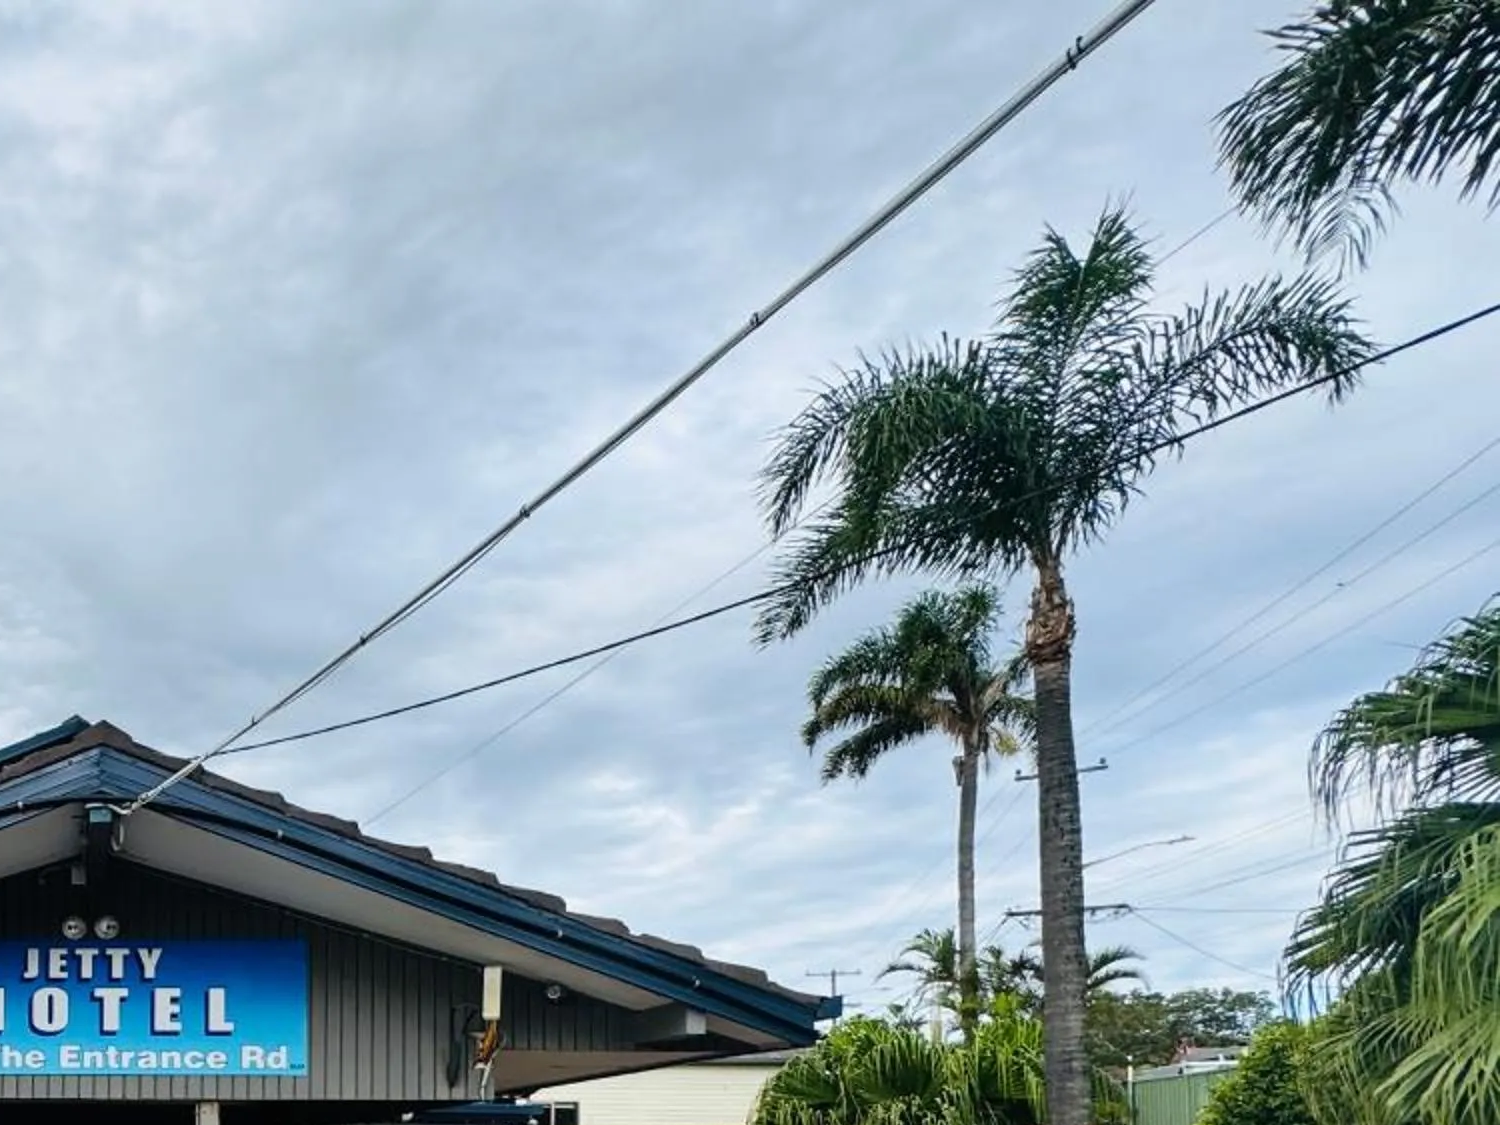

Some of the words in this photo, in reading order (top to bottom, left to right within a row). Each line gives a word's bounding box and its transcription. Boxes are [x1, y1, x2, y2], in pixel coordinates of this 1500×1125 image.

[22, 947, 163, 980] JETTY
[60, 1044, 228, 1070] Entrance
[241, 1044, 288, 1070] Rd
